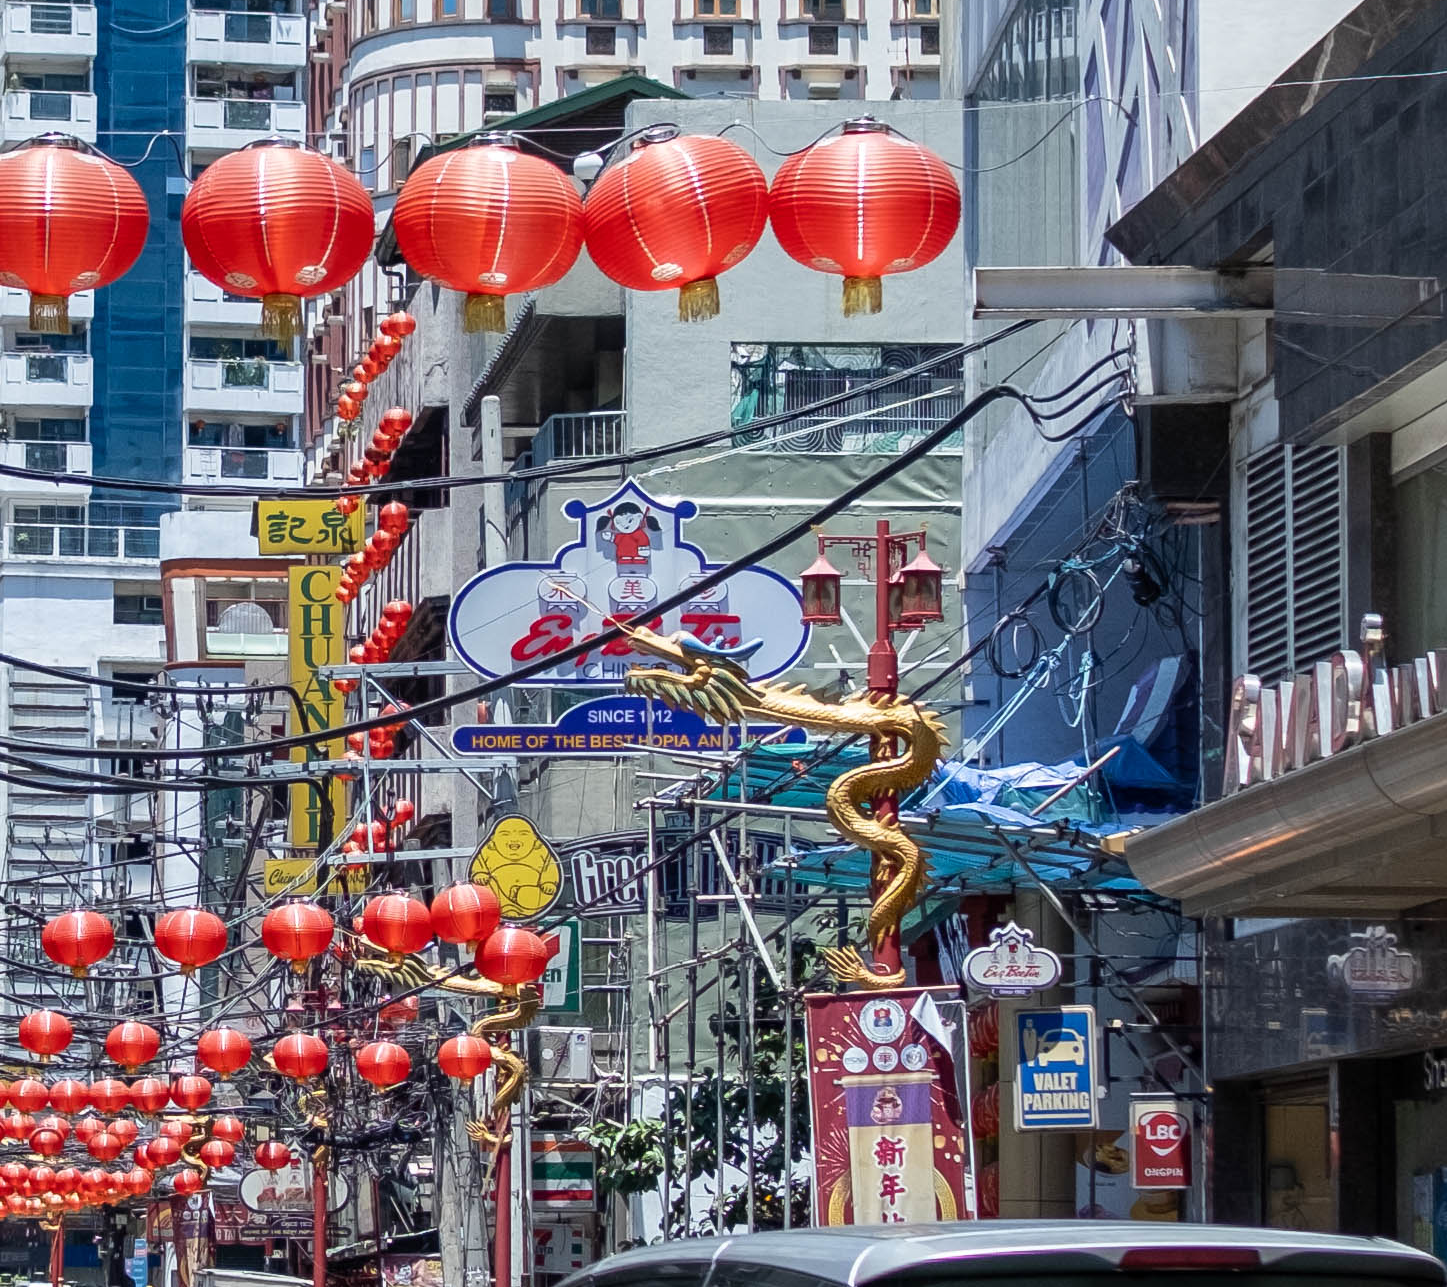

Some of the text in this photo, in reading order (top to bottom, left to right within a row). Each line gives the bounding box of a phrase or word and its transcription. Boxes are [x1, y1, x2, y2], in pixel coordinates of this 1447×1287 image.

[588, 709, 635, 724] SINCE
[472, 735, 522, 749] HOME
[526, 735, 550, 749] OF
[554, 735, 587, 749] THE
[591, 735, 634, 749] BEST
[639, 734, 691, 748] HOPIA
[1033, 1072, 1079, 1091] VALET
[1024, 1092, 1090, 1111] PARKING
[1146, 1123, 1181, 1140] LBC
[1144, 1167, 1184, 1177] ONGPIN
